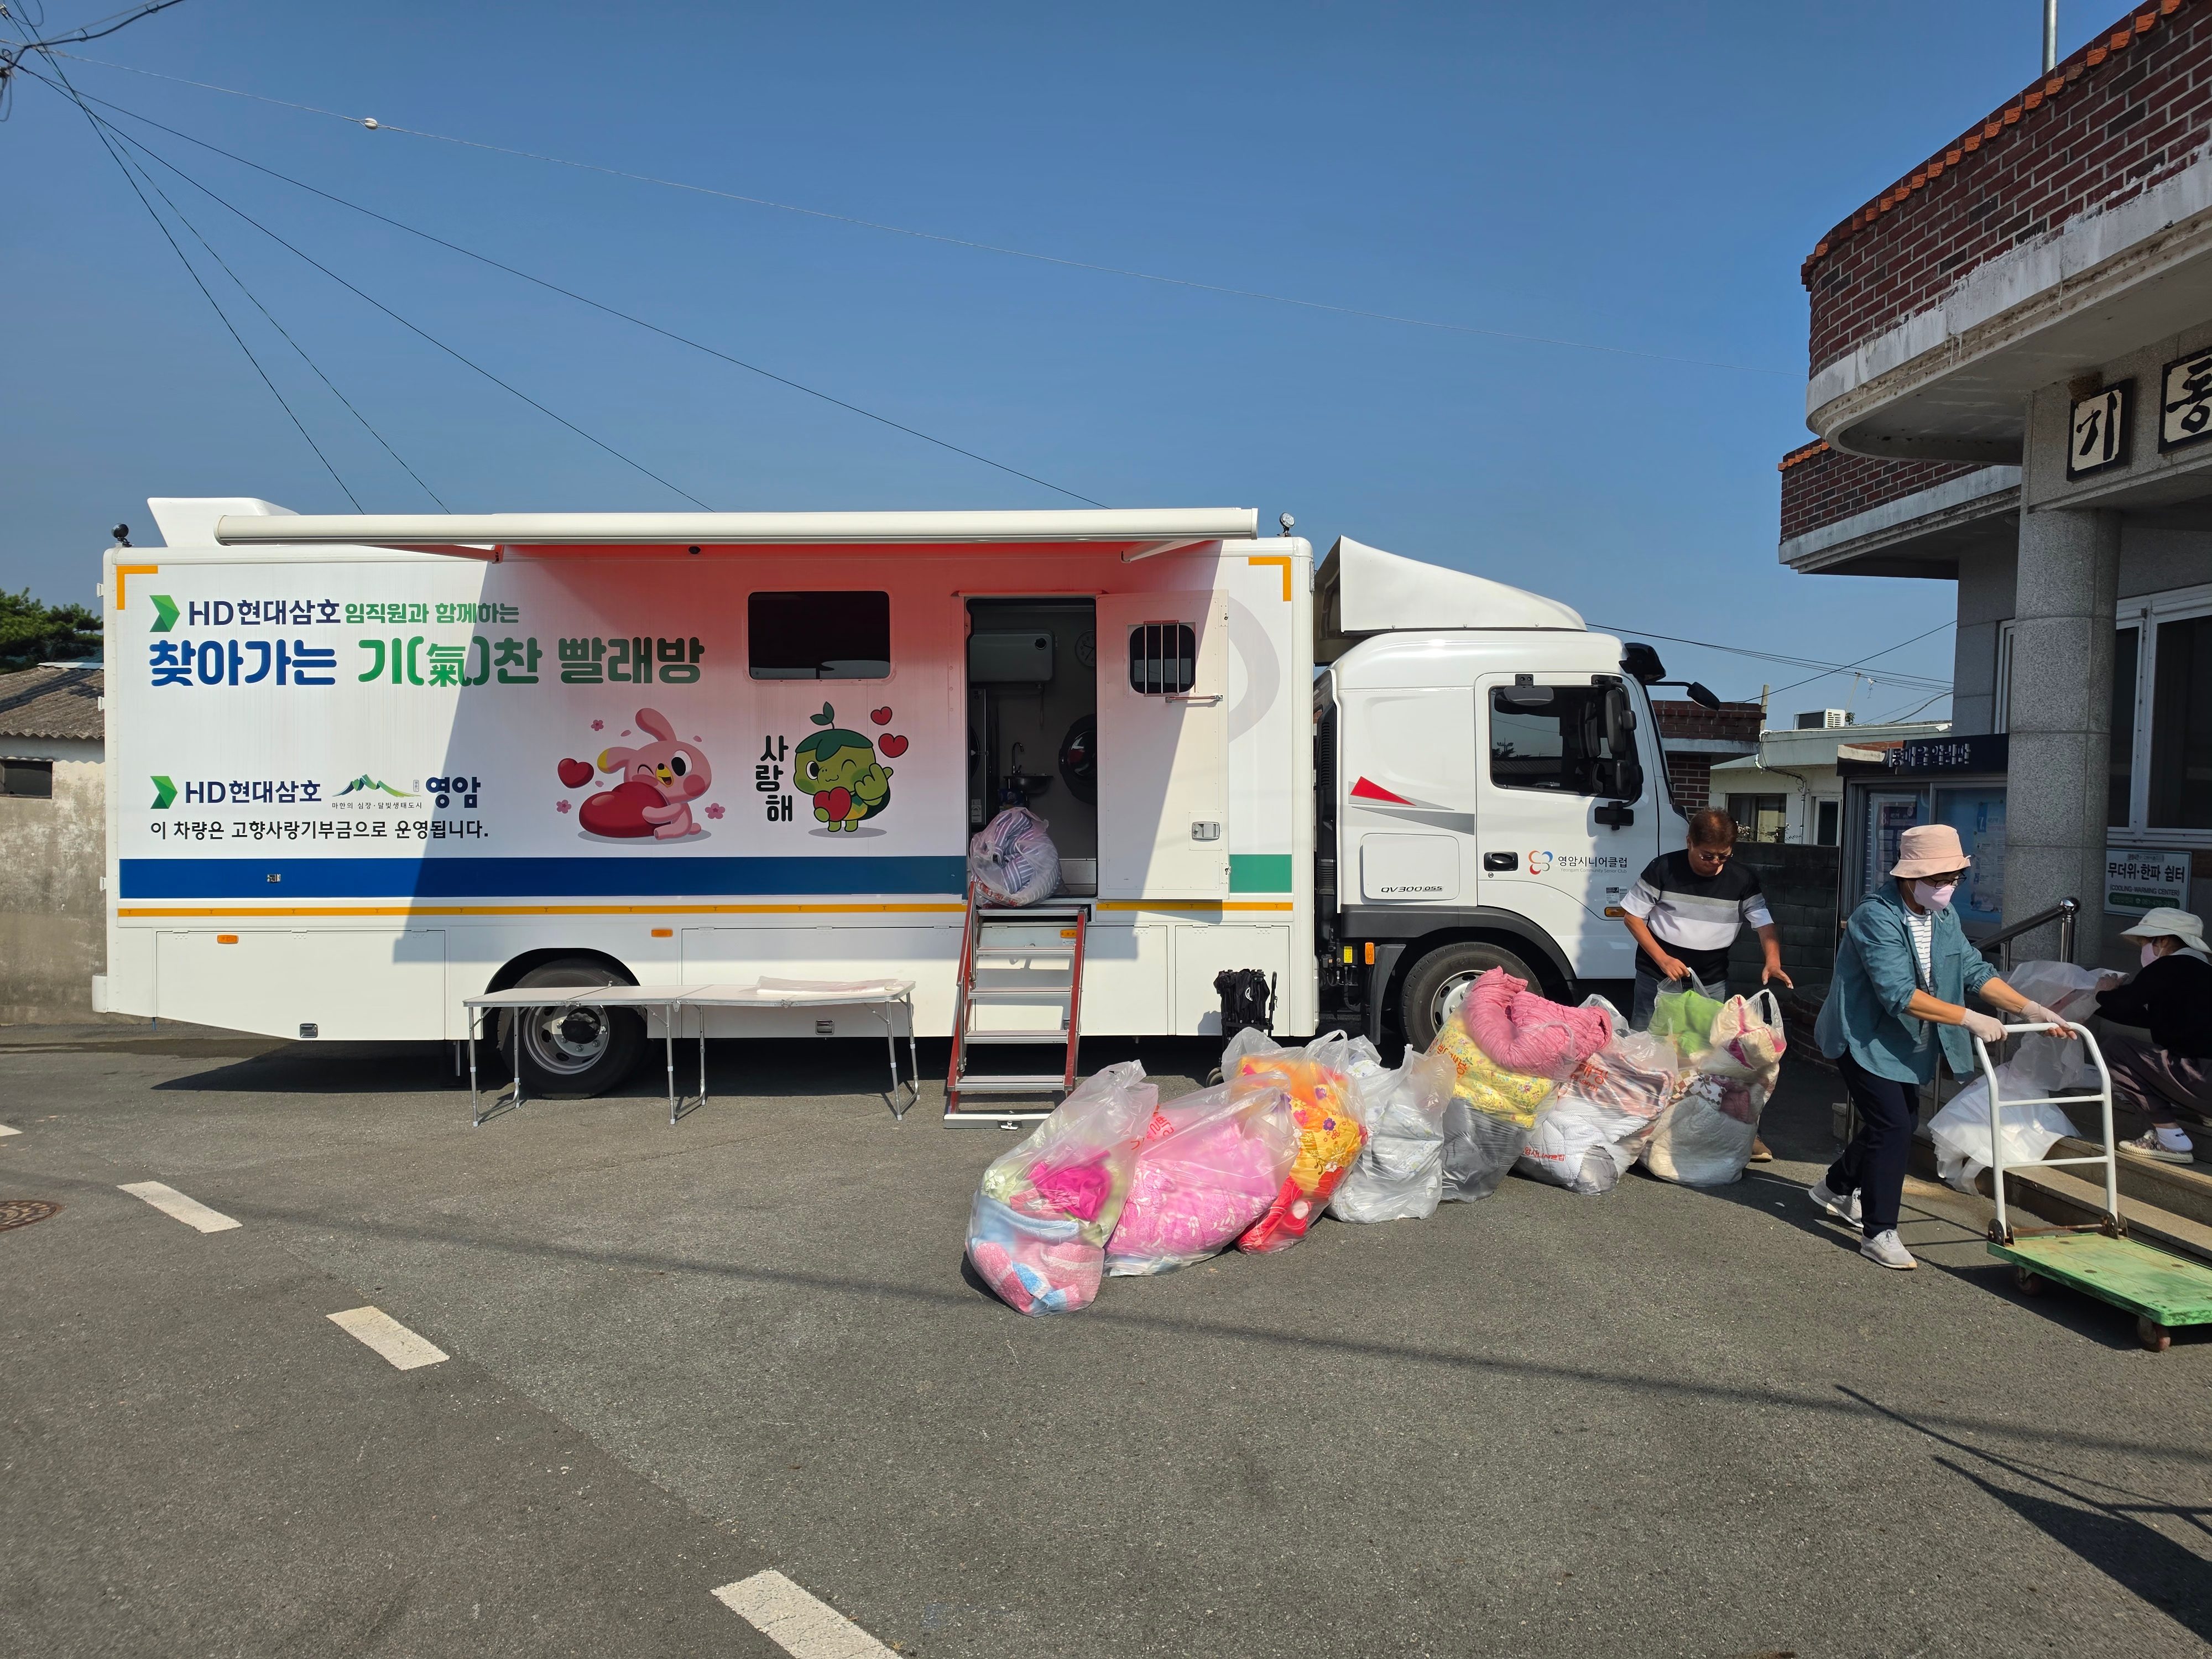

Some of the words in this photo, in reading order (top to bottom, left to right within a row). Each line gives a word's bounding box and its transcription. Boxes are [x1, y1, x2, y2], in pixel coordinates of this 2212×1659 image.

[345, 603, 429, 624] 임직원과
[435, 603, 519, 624] 함께하는
[149, 639, 337, 687] 찾아가는
[358, 636, 543, 687] 기(氣)찬
[558, 637, 705, 684] 빨래방
[755, 735, 792, 822] 사랑해
[425, 777, 481, 809] 영암
[150, 822, 165, 839] 이
[174, 821, 224, 839] 차량은
[232, 821, 388, 839] 고향사랑기부금으로
[394, 820, 489, 839] 운영됩니다.
[1558, 856, 1627, 868] 영암시니어클럽
[2164, 865, 2185, 883] 쉼터
[2158, 888, 2180, 897] CENTER)
